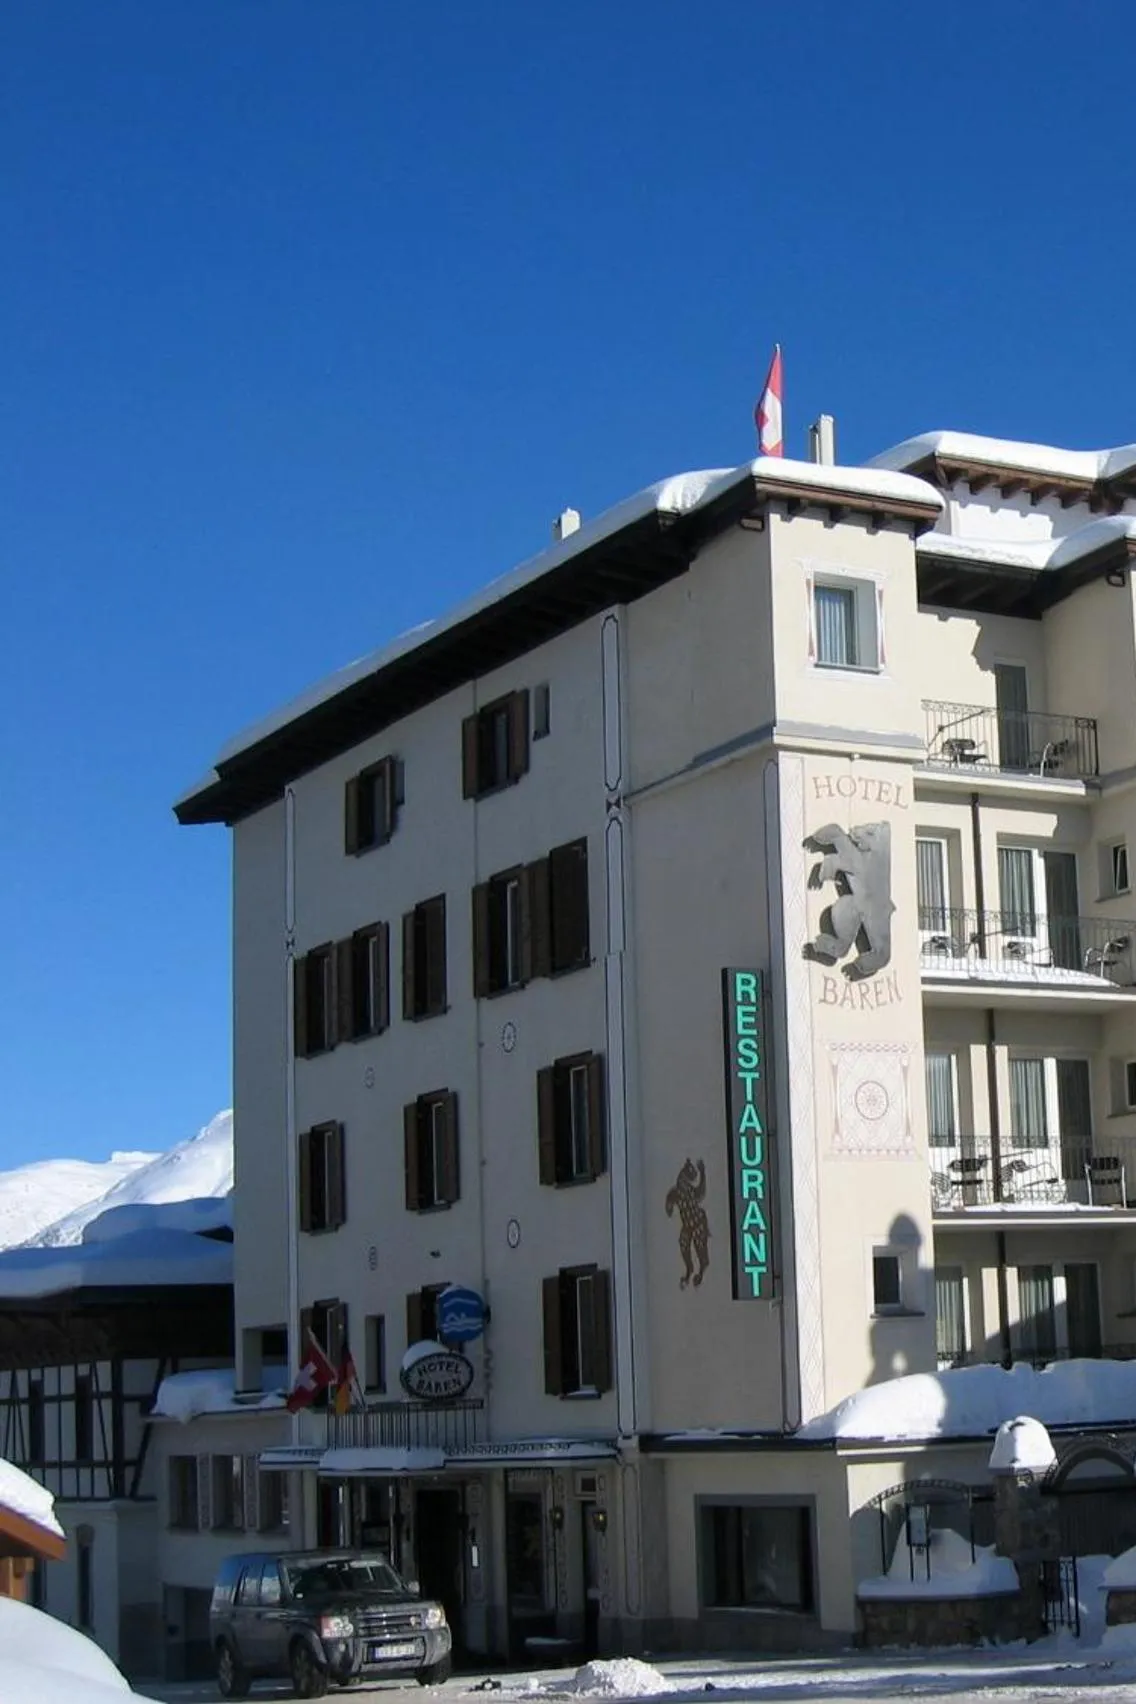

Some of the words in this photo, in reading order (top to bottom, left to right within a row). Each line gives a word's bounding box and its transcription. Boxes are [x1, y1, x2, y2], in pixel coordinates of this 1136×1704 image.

[811, 774, 909, 810] HOTEL
[735, 972, 768, 1297] RESTAURANT
[416, 1360, 462, 1376] HOTEL
